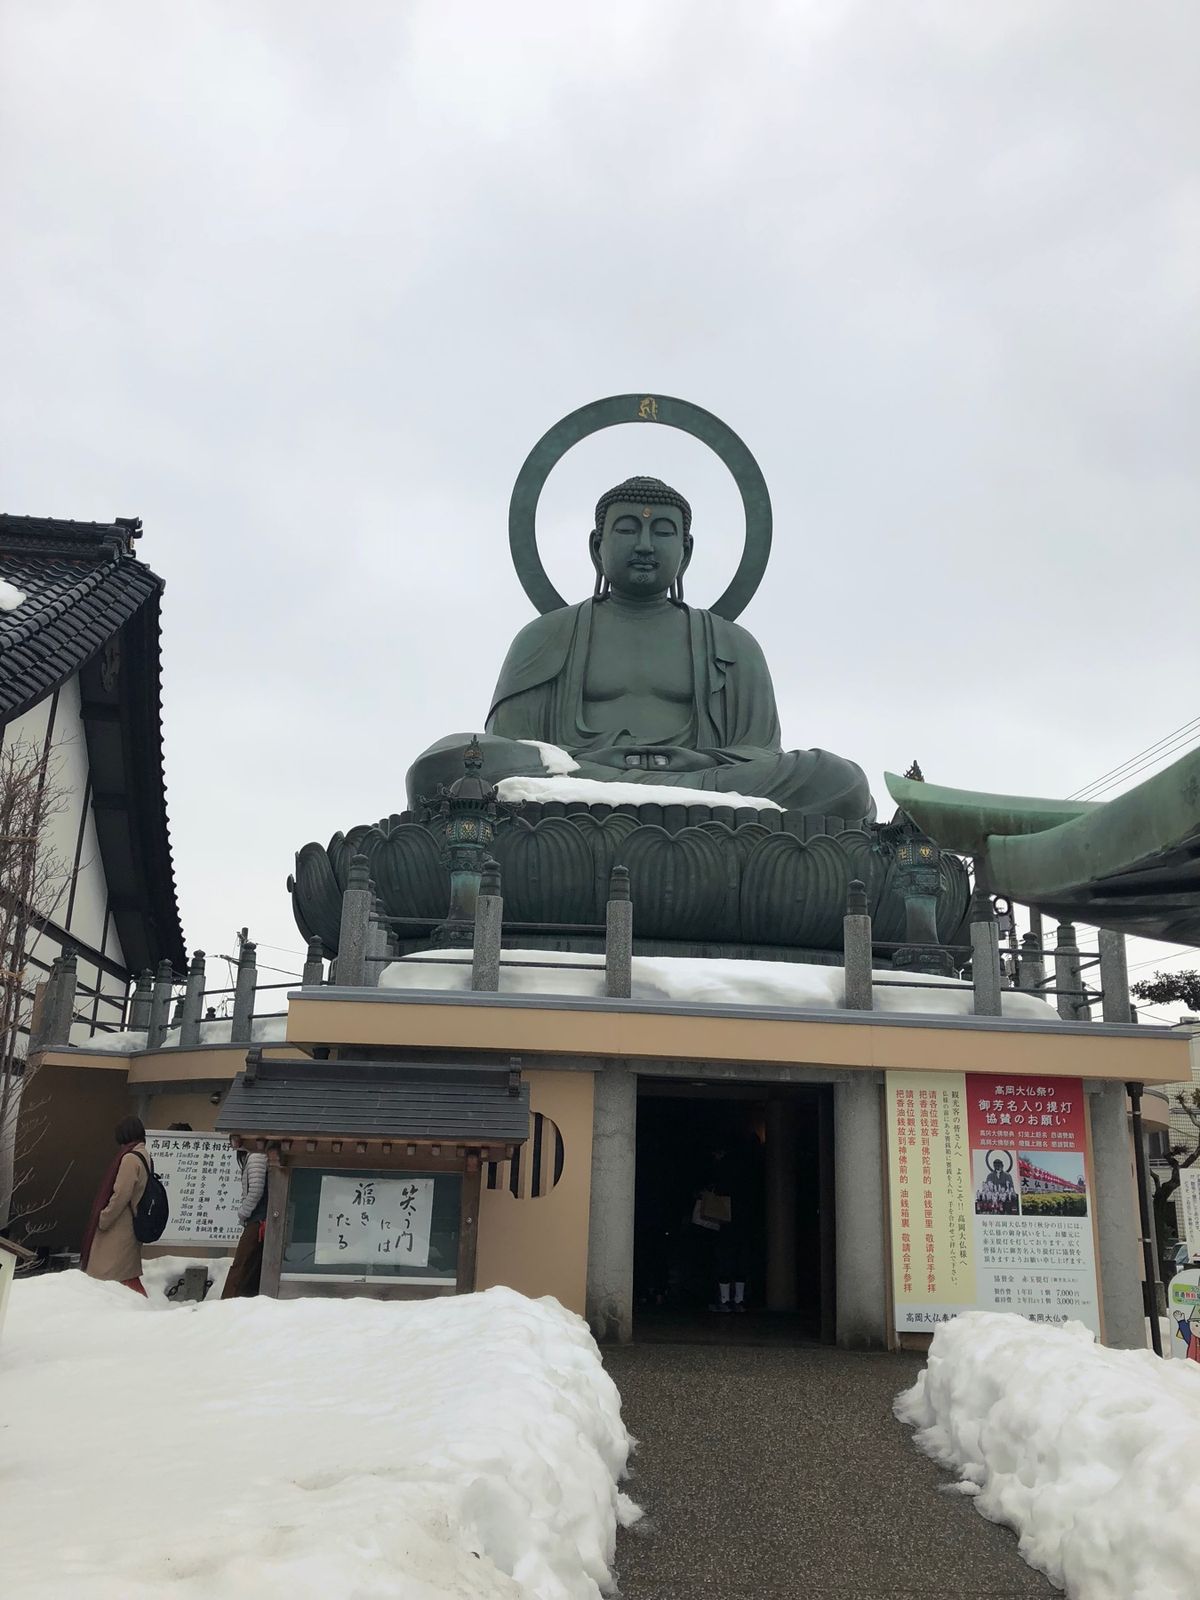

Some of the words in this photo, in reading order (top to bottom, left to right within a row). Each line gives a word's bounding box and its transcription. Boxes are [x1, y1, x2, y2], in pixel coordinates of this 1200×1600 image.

[995, 1085, 1055, 1097] 高岡大仏祭り
[978, 1099, 1072, 1113] 御芳名入り提灯
[952, 1091, 962, 1157] 観光客の皆さんへ
[986, 1113, 1066, 1126] 協賛のお願い
[378, 1219, 391, 1253] には
